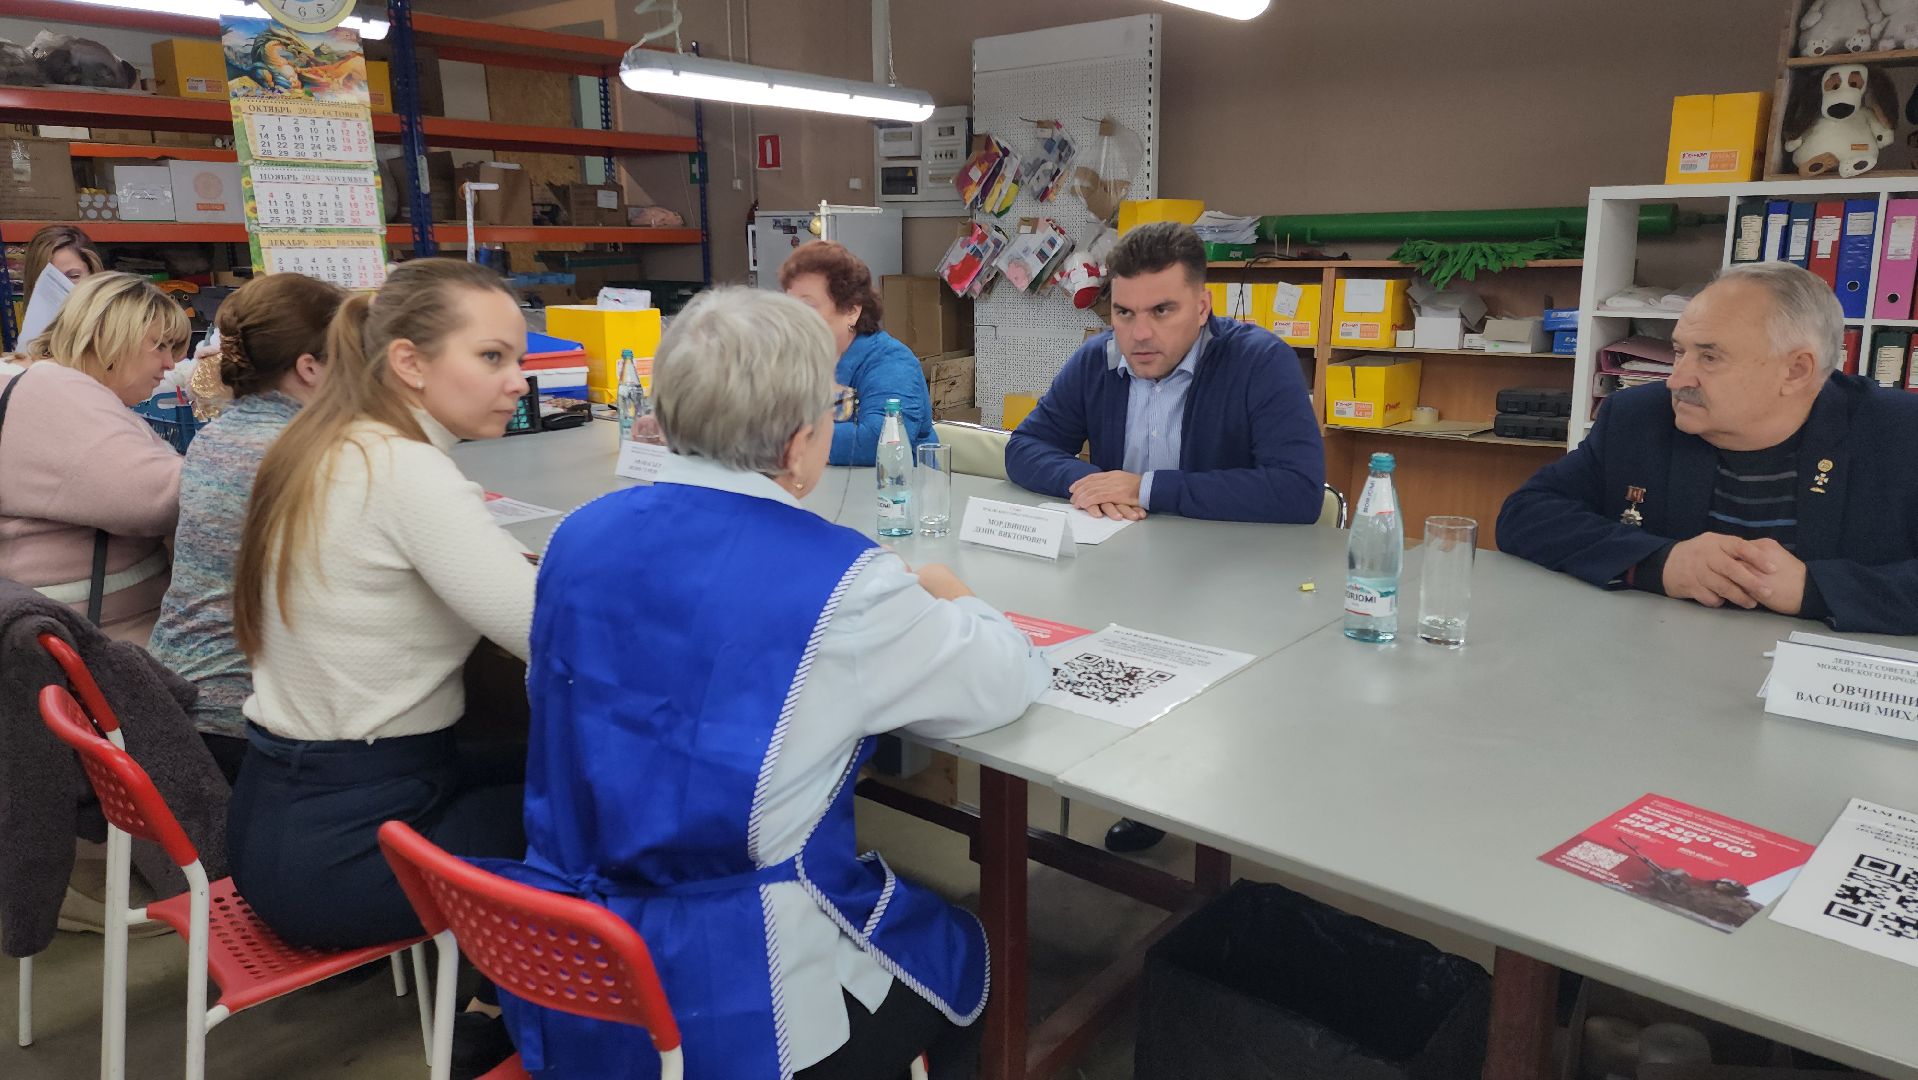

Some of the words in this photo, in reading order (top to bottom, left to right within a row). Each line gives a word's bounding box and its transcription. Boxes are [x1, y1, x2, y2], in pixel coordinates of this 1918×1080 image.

[298, 6, 307, 17] 6
[248, 104, 292, 114] ОКТЯБРЬ
[298, 107, 317, 115] 2024
[765, 139, 773, 165] 1
[260, 173, 299, 181] НОЯБРЬ
[302, 173, 321, 181] 2024
[269, 239, 309, 247] ДЕКАБРЬ
[1831, 657, 1873, 671] ДЕПУТАТ
[1795, 691, 1871, 714] ВАСИЛИЙ
[1712, 841, 1758, 858] 000
